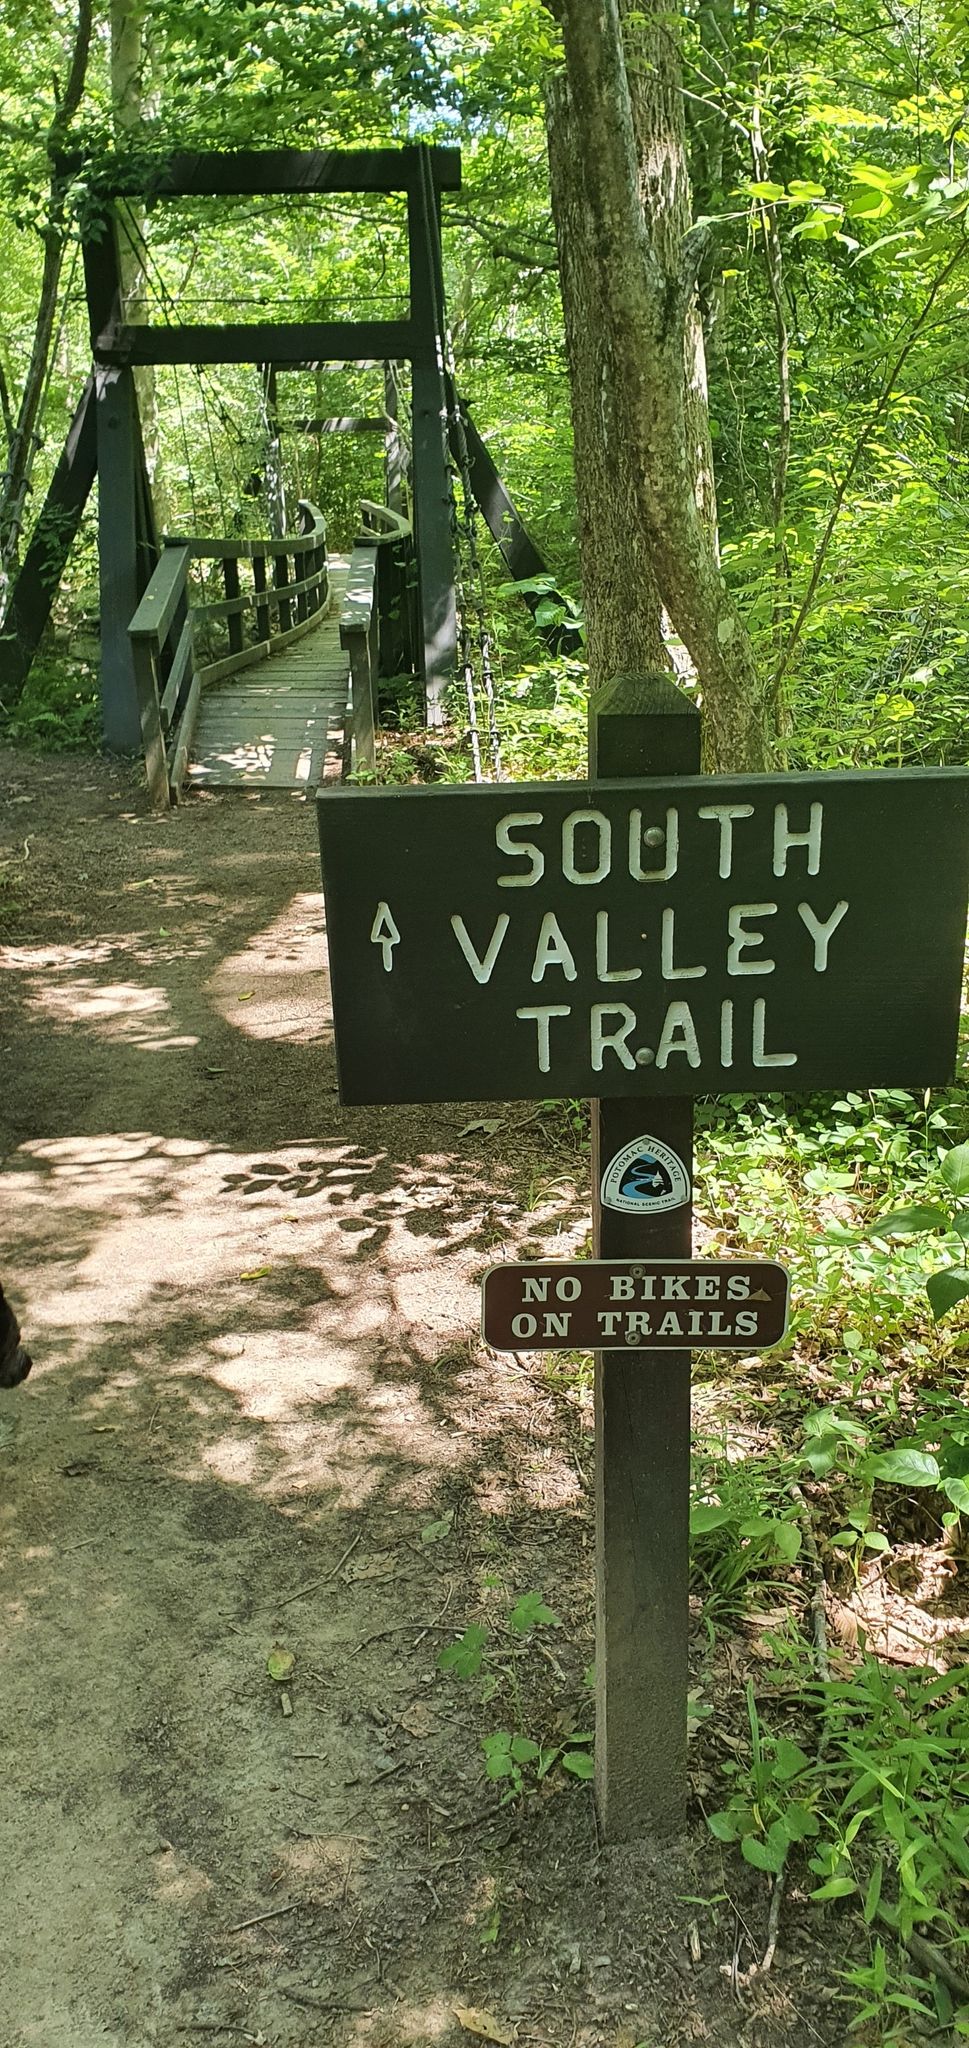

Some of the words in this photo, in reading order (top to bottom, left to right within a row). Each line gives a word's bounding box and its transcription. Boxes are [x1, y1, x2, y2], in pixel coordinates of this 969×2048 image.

[496, 801, 824, 888] SOUTH
[450, 900, 849, 984] VALLEY
[516, 999, 798, 1072] TRAIL
[610, 1146, 644, 1183] POTOMAC
[647, 1145, 682, 1183] HERITAGE
[616, 1198, 640, 1207] NATIONAL
[521, 1276, 582, 1303] NO
[609, 1275, 751, 1301] BIKES
[511, 1312, 572, 1338] ON
[597, 1311, 758, 1337] TRAILS
